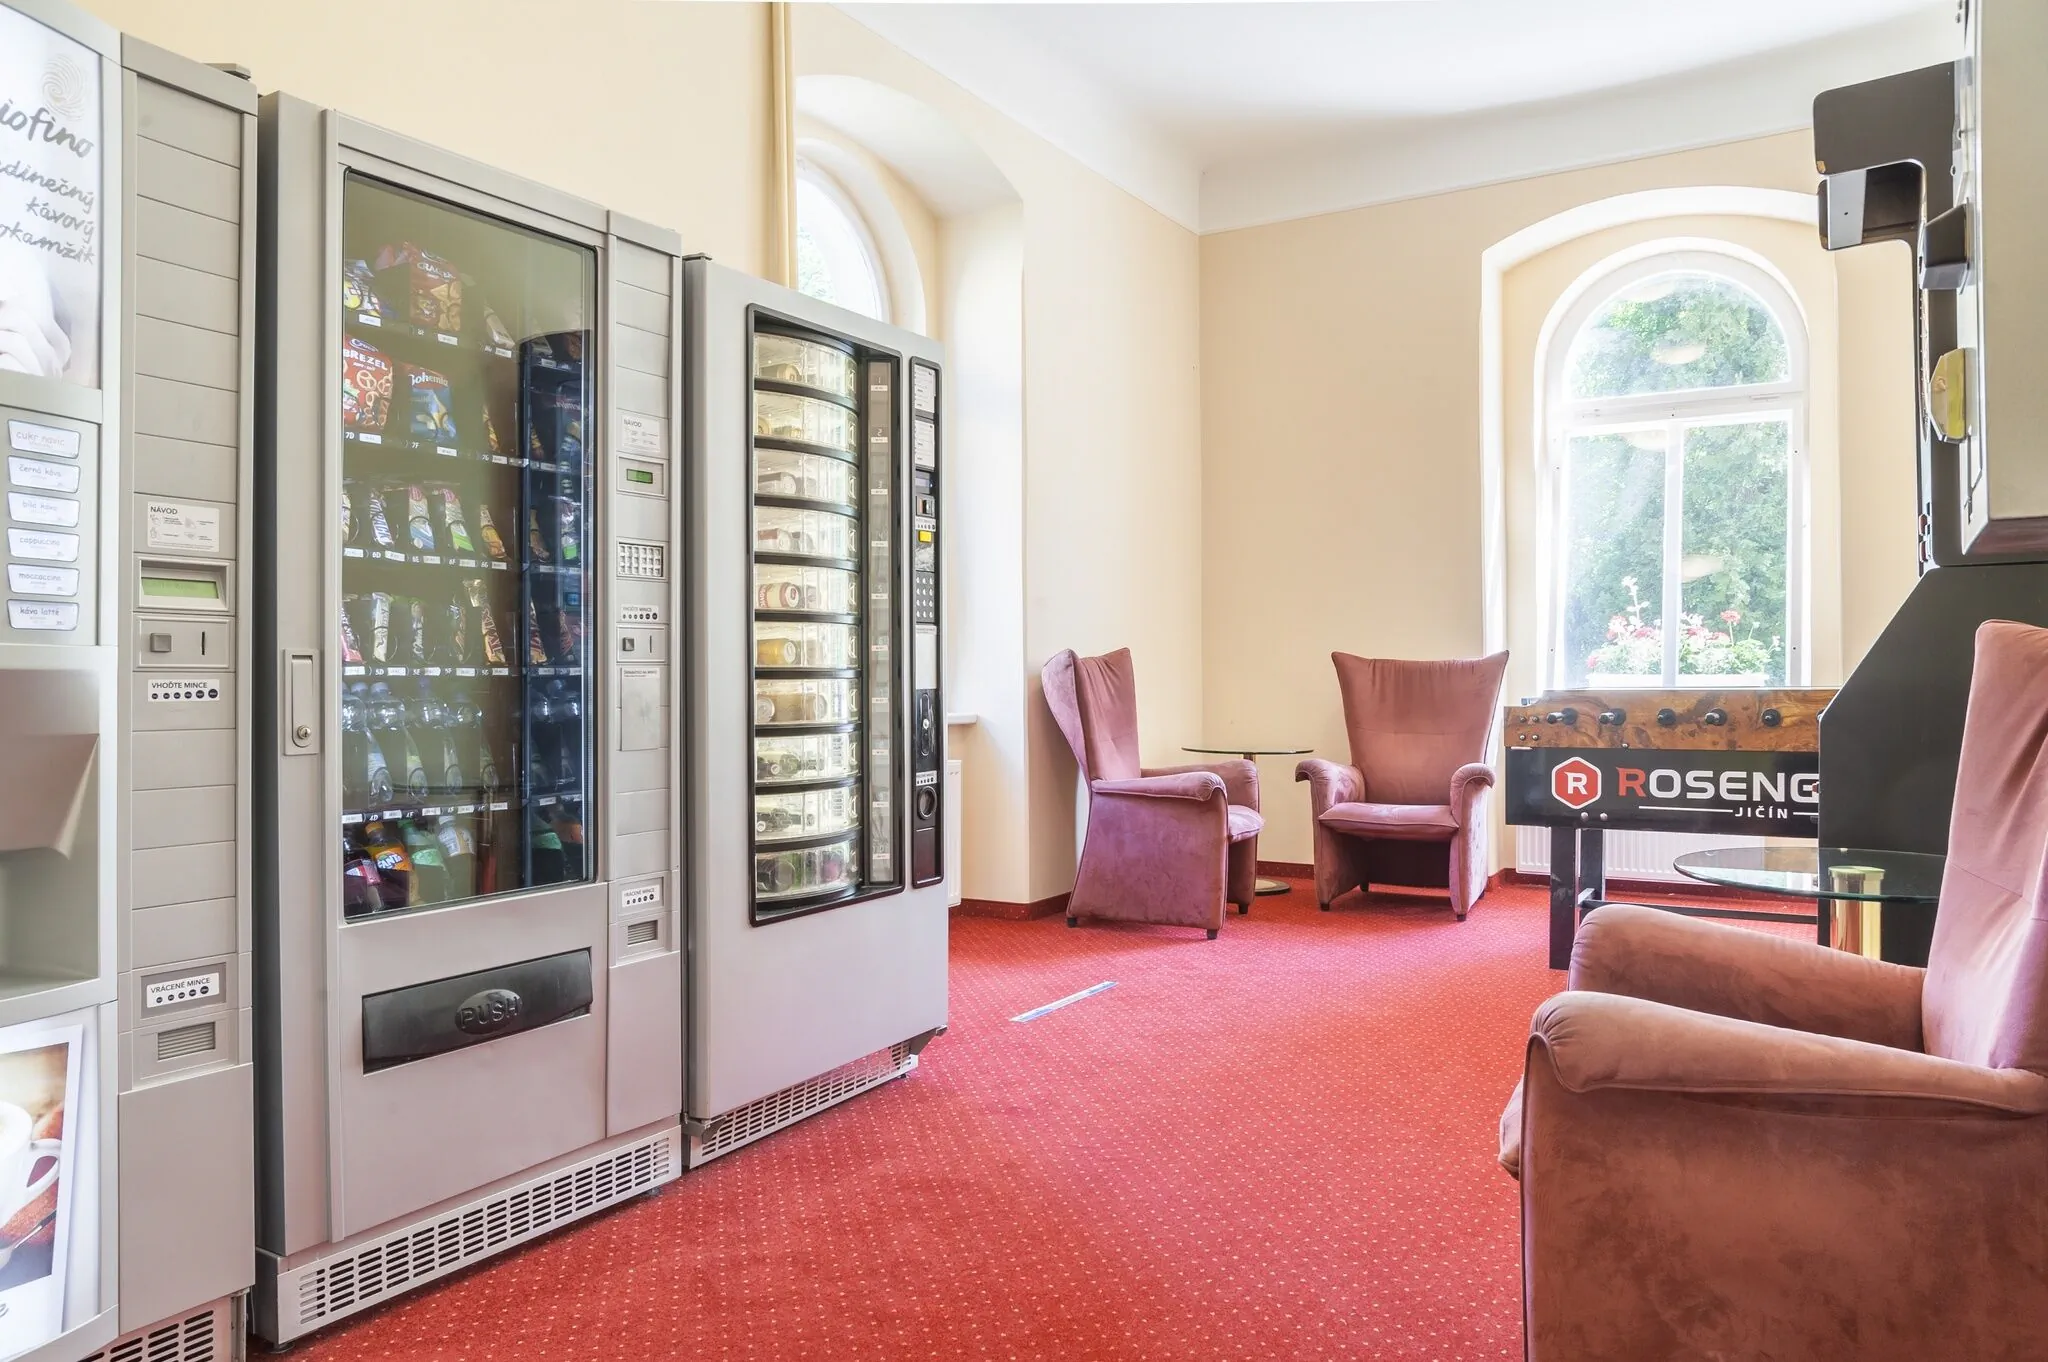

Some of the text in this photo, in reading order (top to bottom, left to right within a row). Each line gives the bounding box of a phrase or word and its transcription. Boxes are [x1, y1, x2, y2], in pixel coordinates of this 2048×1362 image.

[26, 196, 94, 244] kávový
[342, 348, 389, 371] BREZEL
[345, 431, 355, 440] 7D
[150, 505, 178, 515] NÁVOD
[152, 681, 182, 689] VHOĎTE
[1563, 771, 1588, 796] R
[1735, 804, 1789, 820] JIČÍN
[377, 853, 403, 869] FANTA
[151, 977, 211, 993] VRÁCENÉ MINCE
[461, 996, 518, 1029] PUSH
